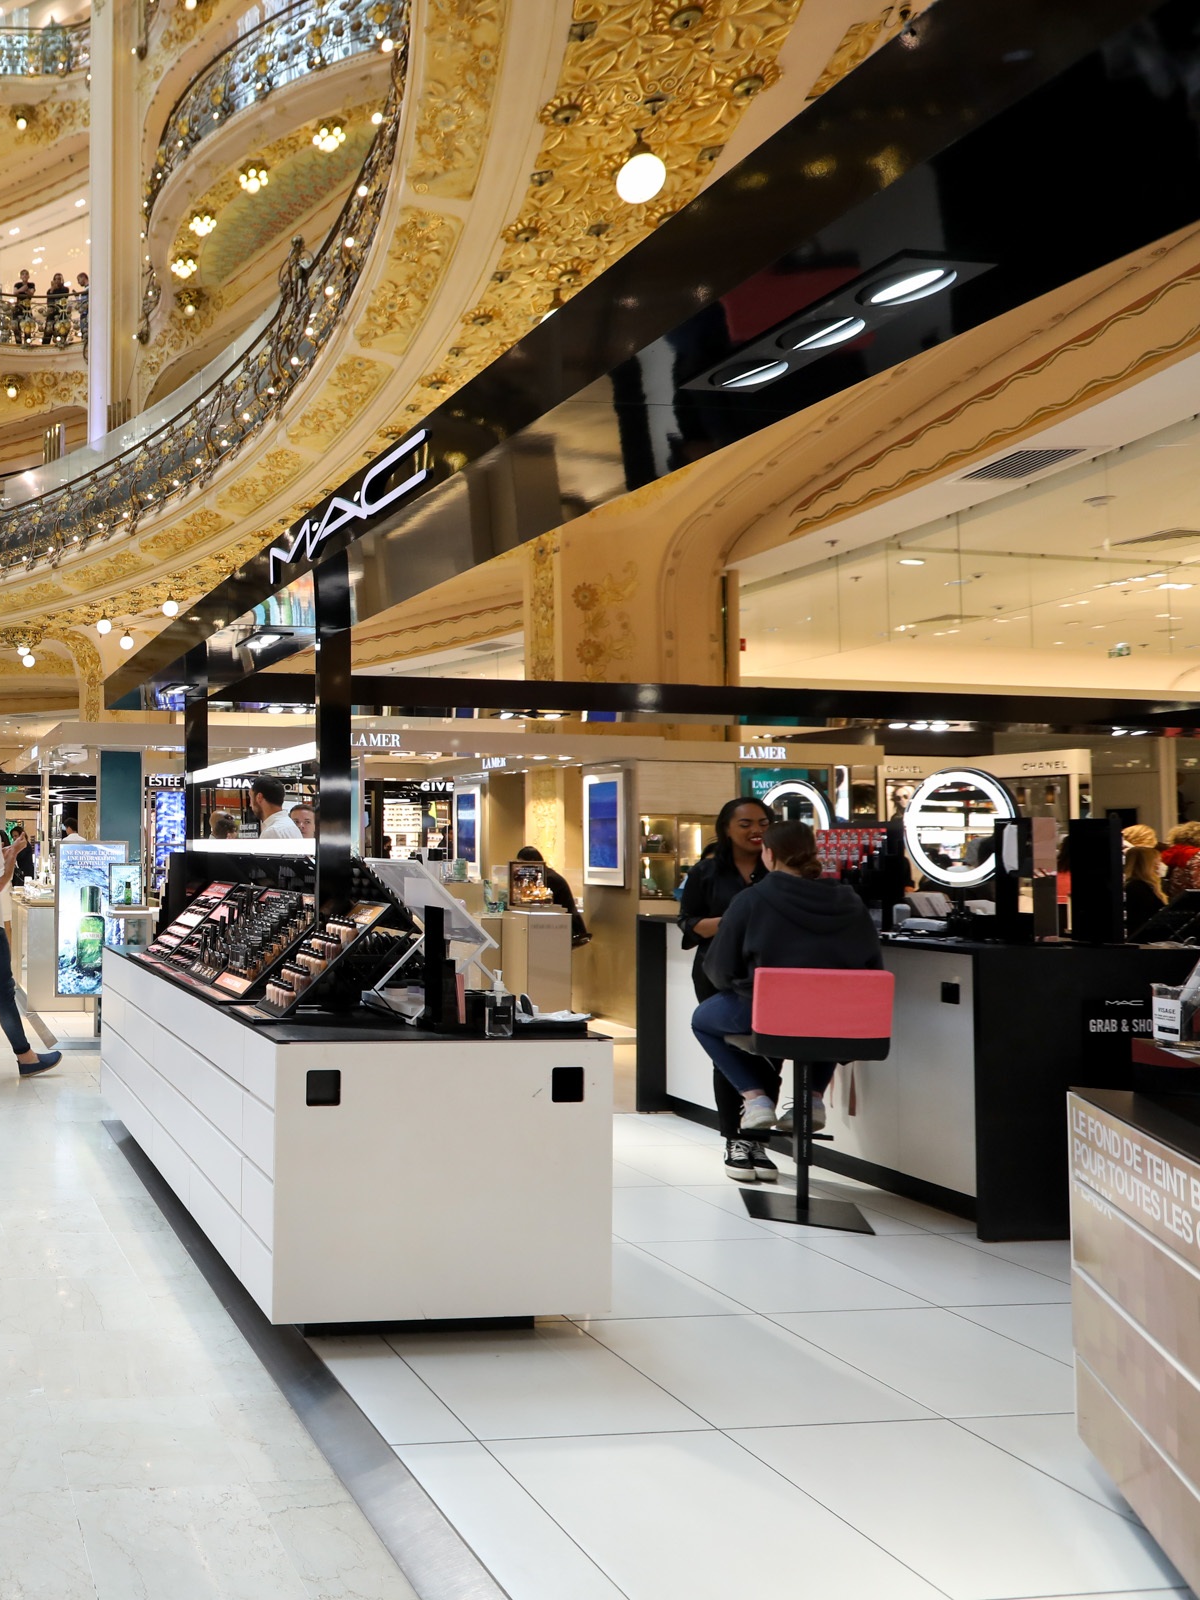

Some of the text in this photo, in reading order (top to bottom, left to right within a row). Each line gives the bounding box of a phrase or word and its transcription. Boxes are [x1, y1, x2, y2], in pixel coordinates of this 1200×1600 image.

[369, 732, 401, 748] MER
[739, 745, 787, 760] LA MER
[887, 765, 924, 774] CHANEL
[1022, 760, 1068, 771] CHANEL
[420, 781, 455, 792] GIVE
[1089, 1018, 1118, 1033] GRAB
[1120, 1018, 1130, 1033] &
[1073, 1107, 1087, 1138] LE
[1088, 1117, 1121, 1159] FOND
[1123, 1137, 1143, 1174] DE
[1144, 1149, 1187, 1202] TEINT
[1074, 1137, 1106, 1183] POUR
[1107, 1160, 1161, 1221] TOUTES
[1163, 1197, 1193, 1244] LES
[1074, 1168, 1113, 1220] PEAUX
